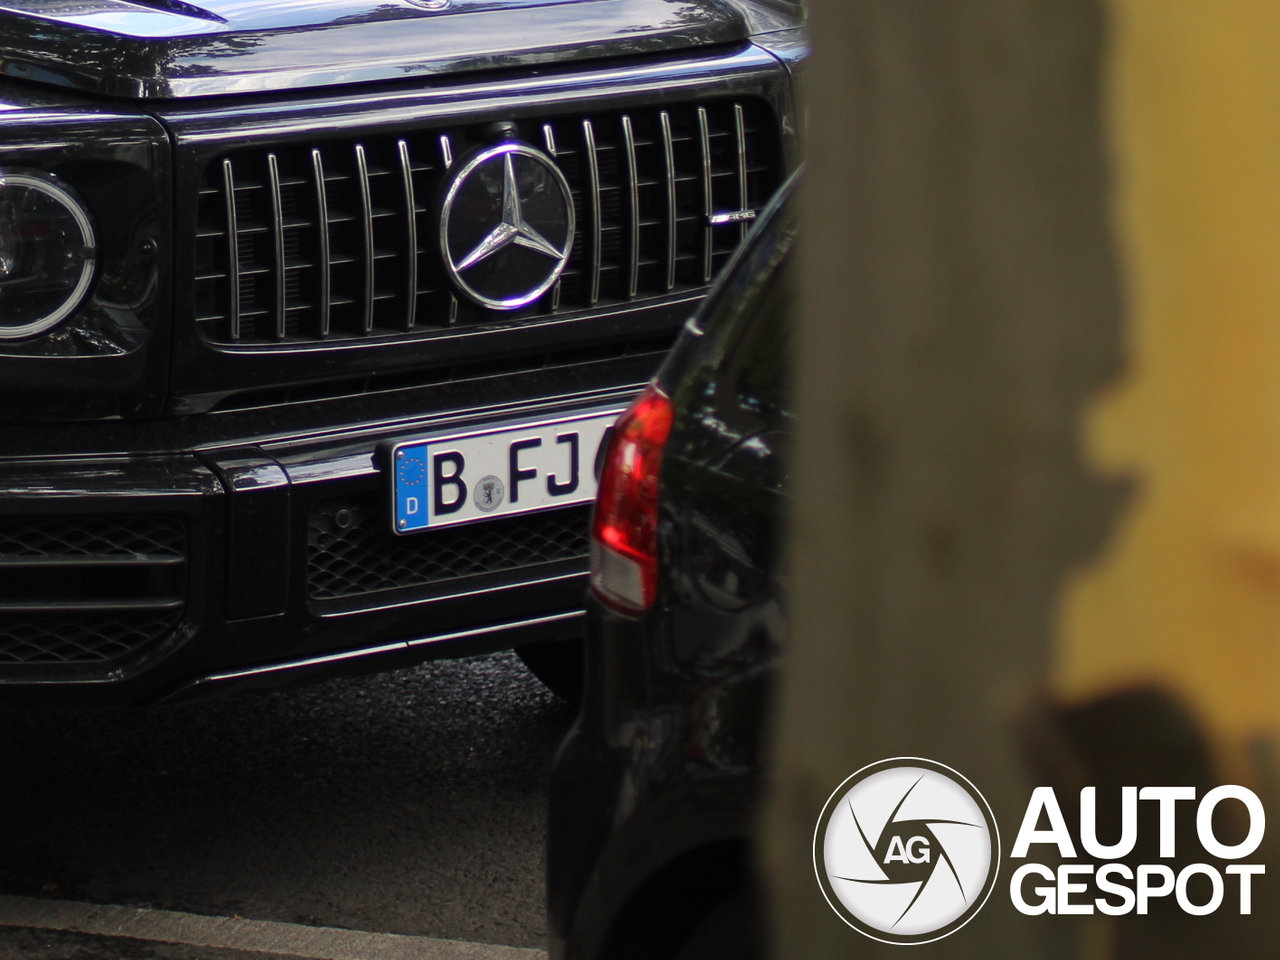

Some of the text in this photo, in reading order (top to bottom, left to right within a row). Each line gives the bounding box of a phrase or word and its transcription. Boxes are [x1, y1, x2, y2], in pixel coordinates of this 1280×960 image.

[727, 210, 756, 221] AMG
[433, 450, 468, 516] B
[509, 431, 579, 503] FJ
[406, 497, 418, 515] D
